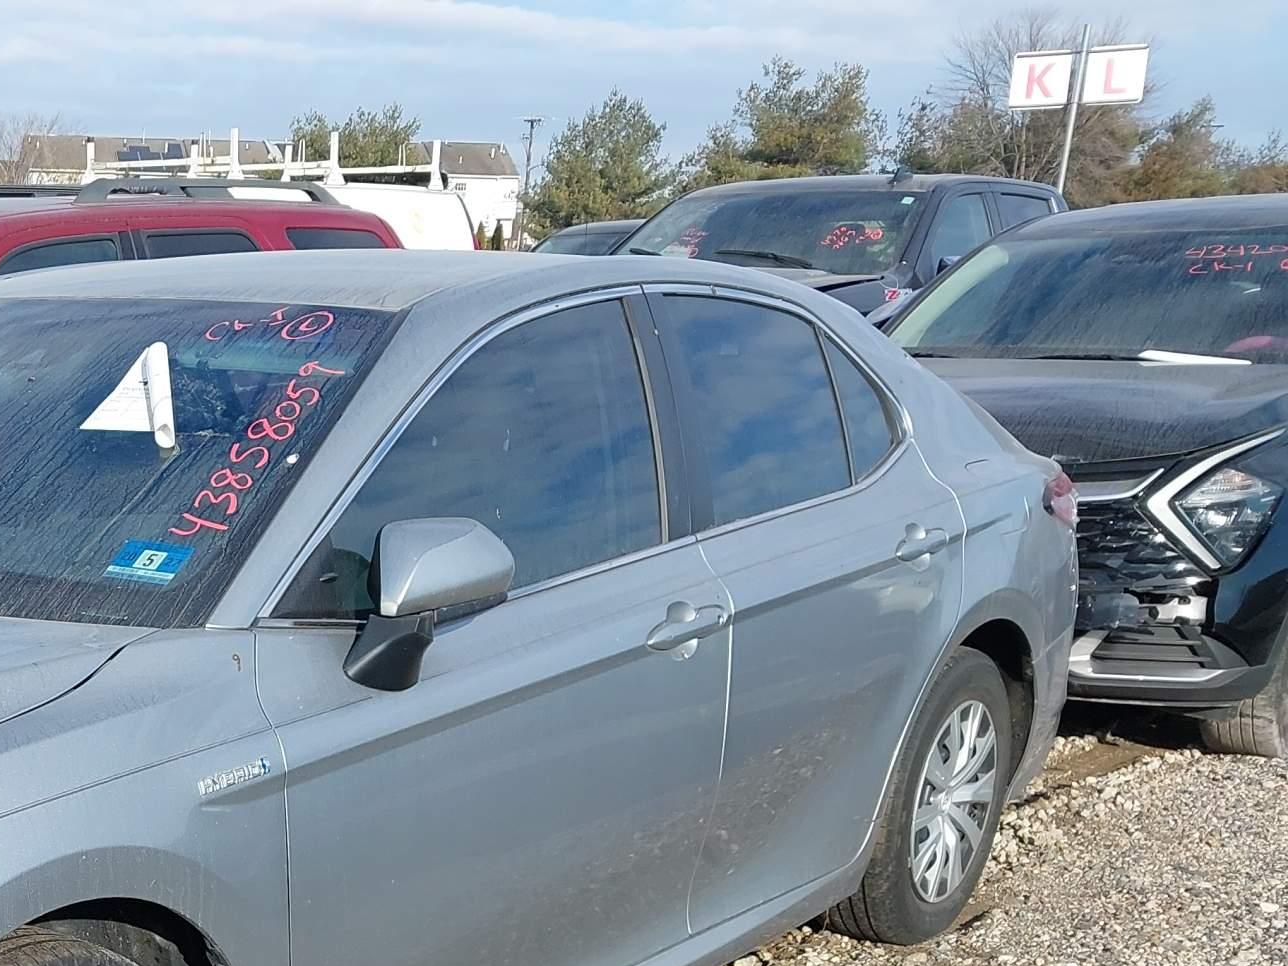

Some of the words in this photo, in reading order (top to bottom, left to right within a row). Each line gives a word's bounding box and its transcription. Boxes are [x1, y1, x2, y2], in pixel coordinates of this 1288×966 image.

[1025, 62, 1056, 99] K
[1103, 58, 1128, 94] L
[168, 361, 345, 536] 43858059
[143, 553, 159, 567] 5
